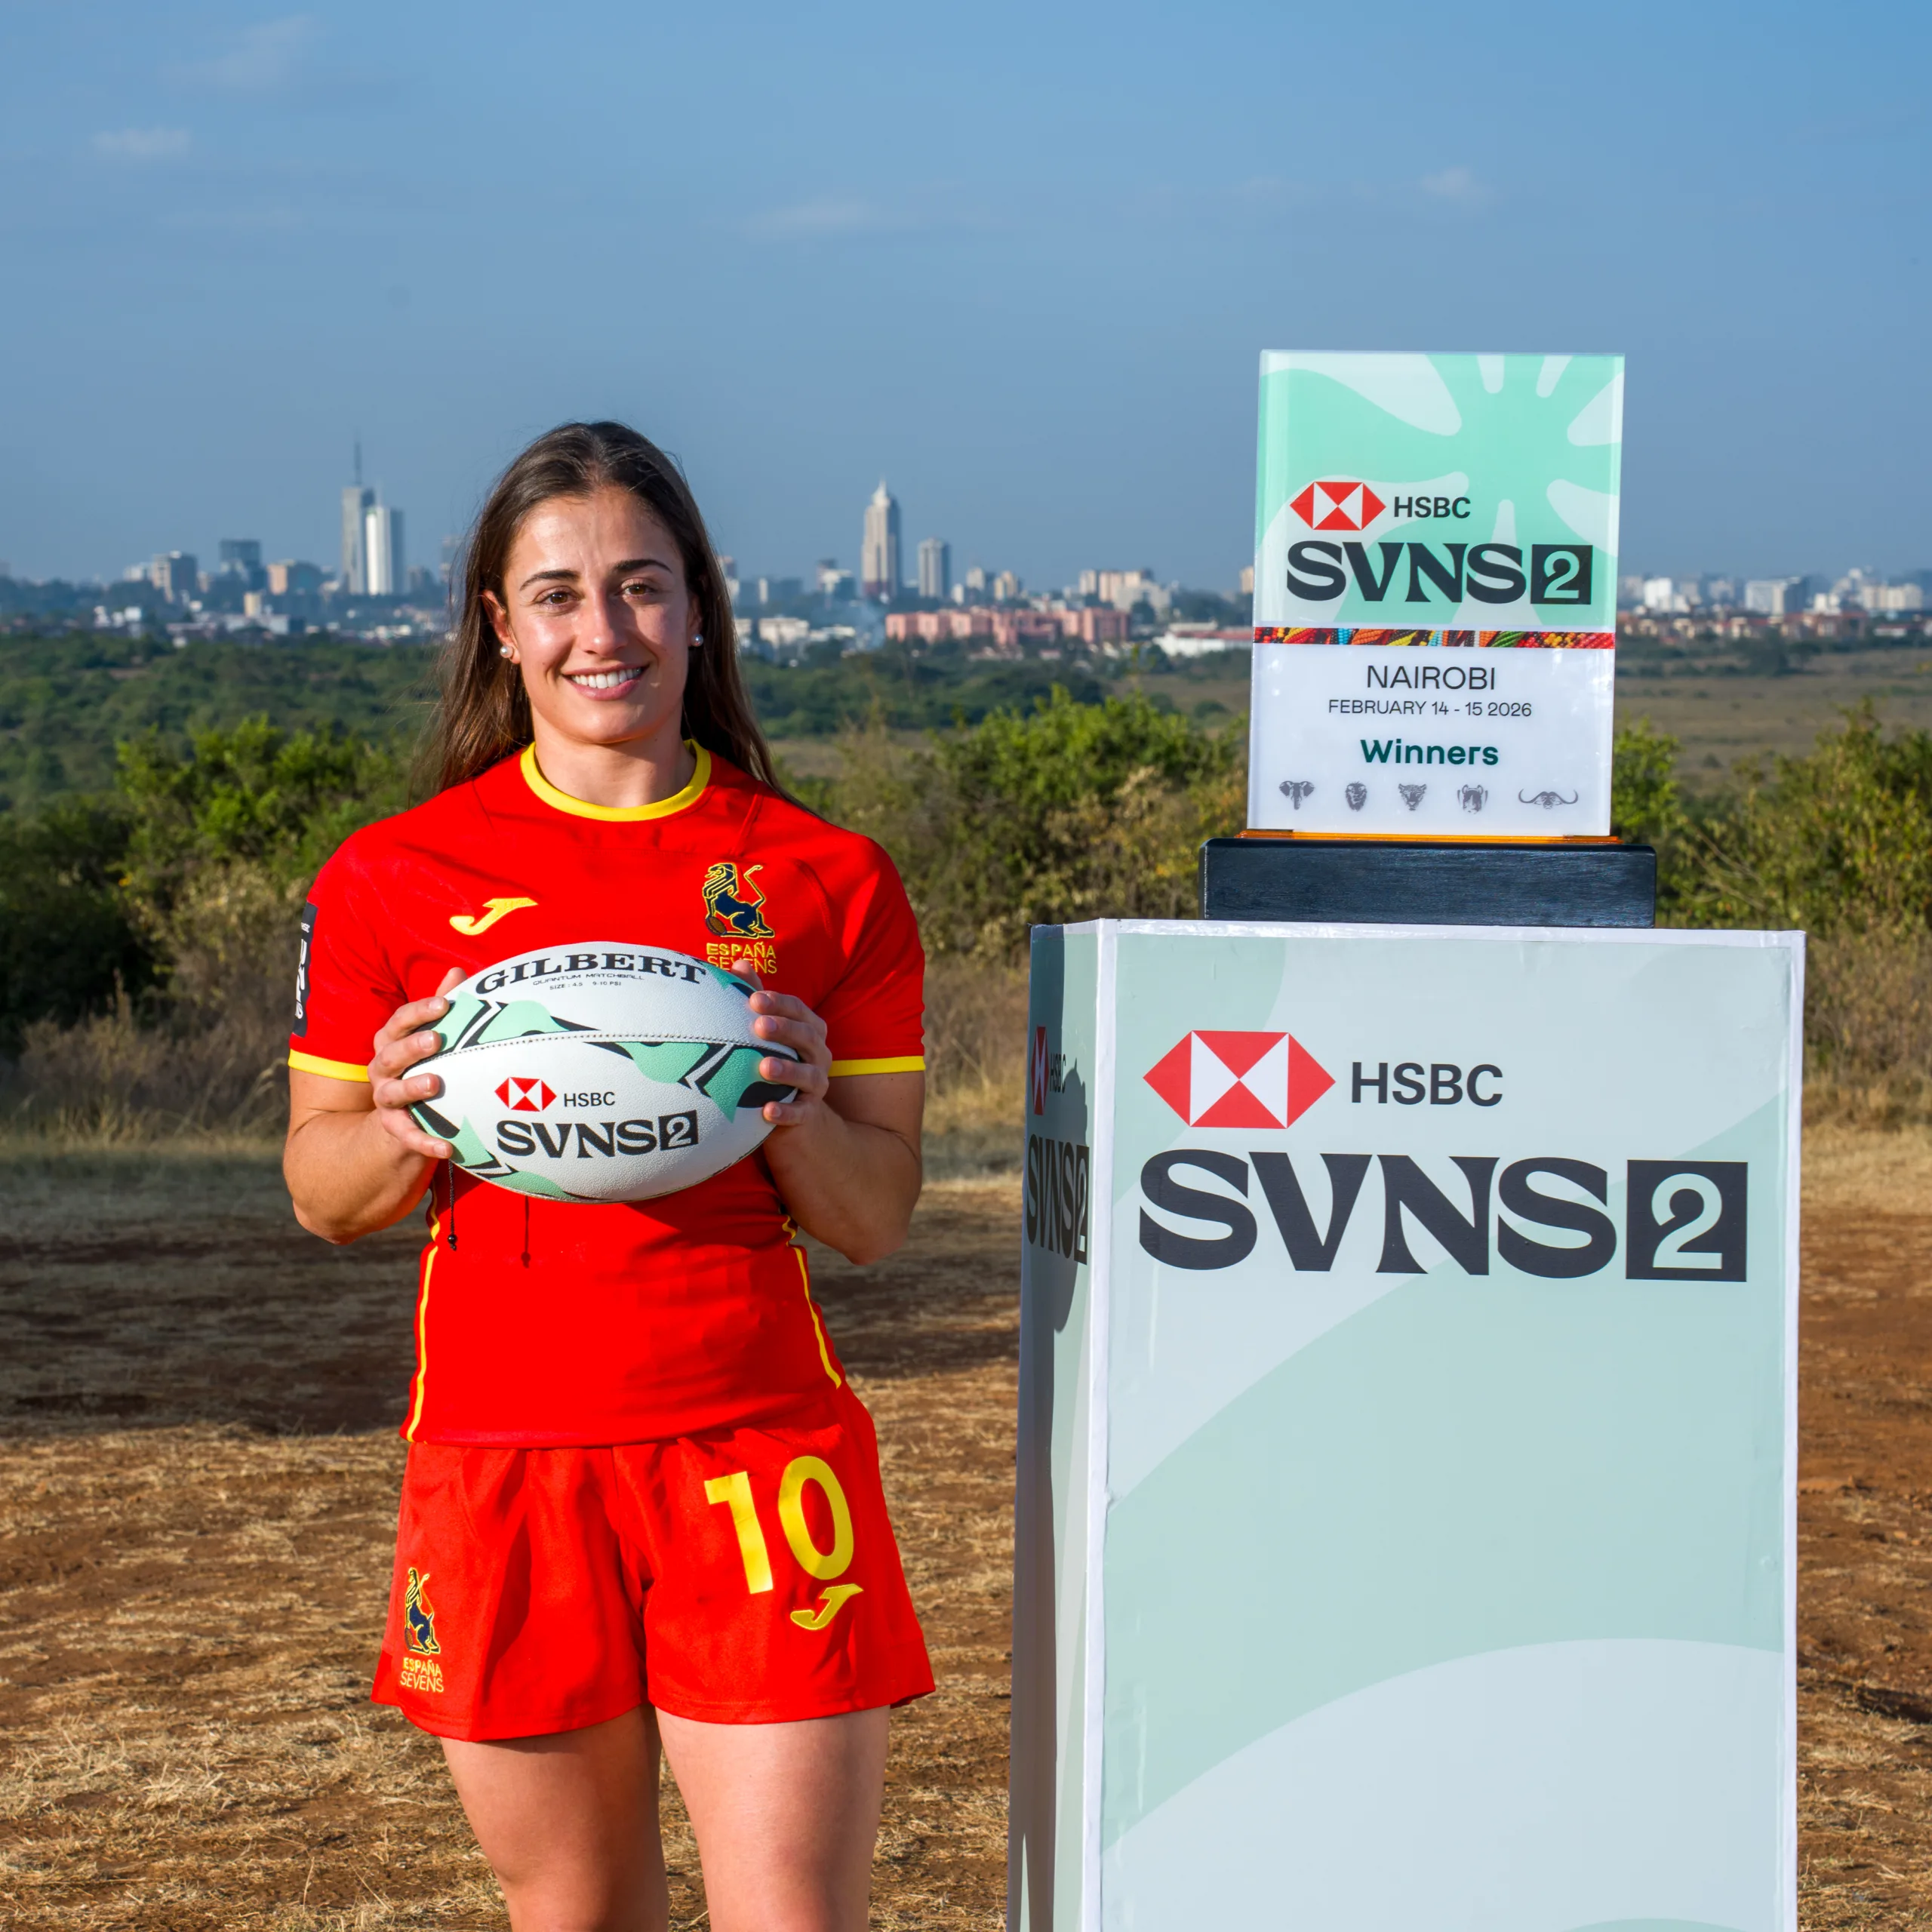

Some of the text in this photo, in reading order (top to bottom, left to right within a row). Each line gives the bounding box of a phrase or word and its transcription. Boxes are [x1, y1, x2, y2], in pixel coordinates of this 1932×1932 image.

[1393, 496, 1471, 519] HSBC
[1367, 665, 1495, 690] NAIROBI
[1328, 699, 1427, 715] FEBRUARY
[1431, 701, 1449, 715] 14
[1465, 702, 1483, 716] 15
[1487, 702, 1532, 717] 2026
[1360, 738, 1499, 765] Winners
[706, 941, 777, 959] ESPAÑA
[475, 952, 706, 995] GILBERT
[533, 974, 581, 986] QUANTUM
[1352, 1061, 1503, 1106] HSBC
[563, 1091, 616, 1108] HSBC
[704, 1455, 854, 1594] 10
[402, 1657, 443, 1678] ESPAÑA
[400, 1671, 444, 1692] SEVENS
